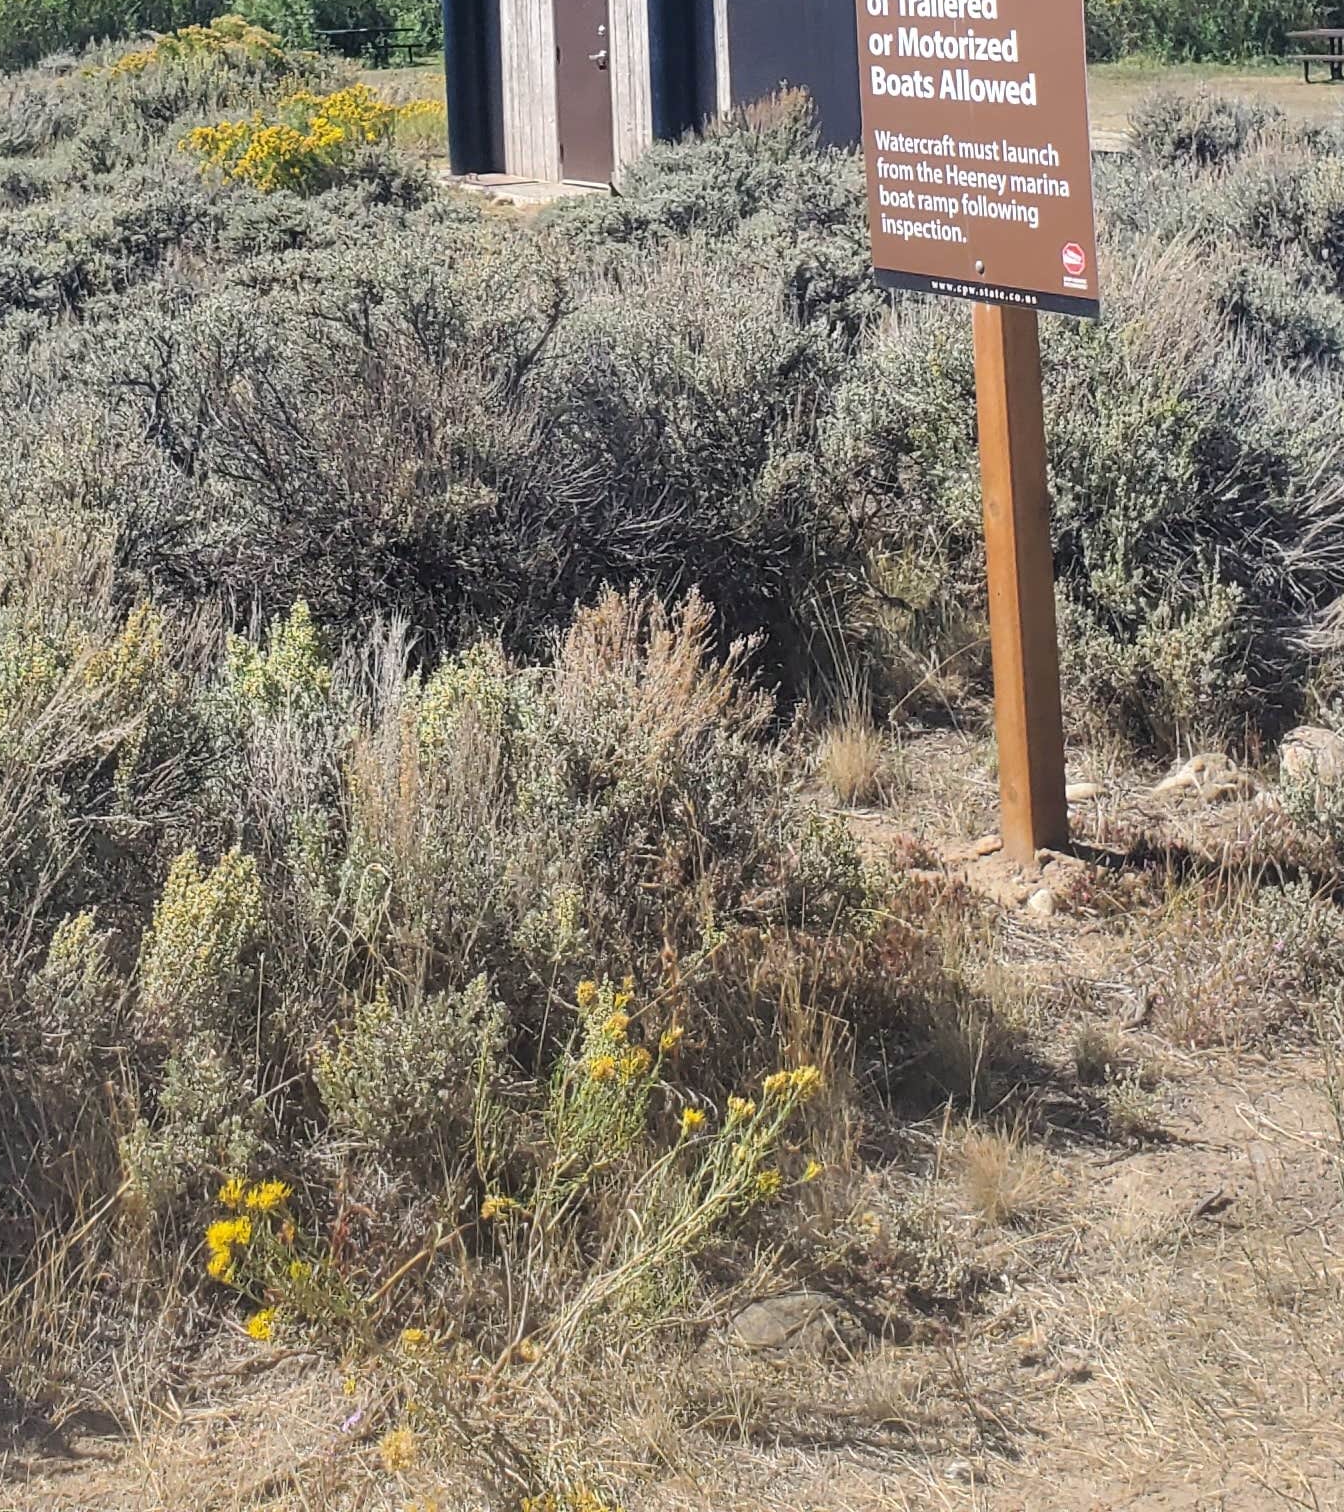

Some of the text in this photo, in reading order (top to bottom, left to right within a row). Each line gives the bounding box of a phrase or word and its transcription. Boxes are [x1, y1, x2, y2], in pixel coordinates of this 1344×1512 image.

[868, 27, 1019, 63] or Motorized
[870, 65, 1037, 106] Boats Allowed
[874, 129, 1059, 166] Watercraft must launch
[877, 157, 1070, 198] from the Heeney marina
[879, 185, 1039, 228] boat ramp following
[881, 213, 967, 243] inspection.
[931, 280, 1038, 304] www.cpw.state.co.us
